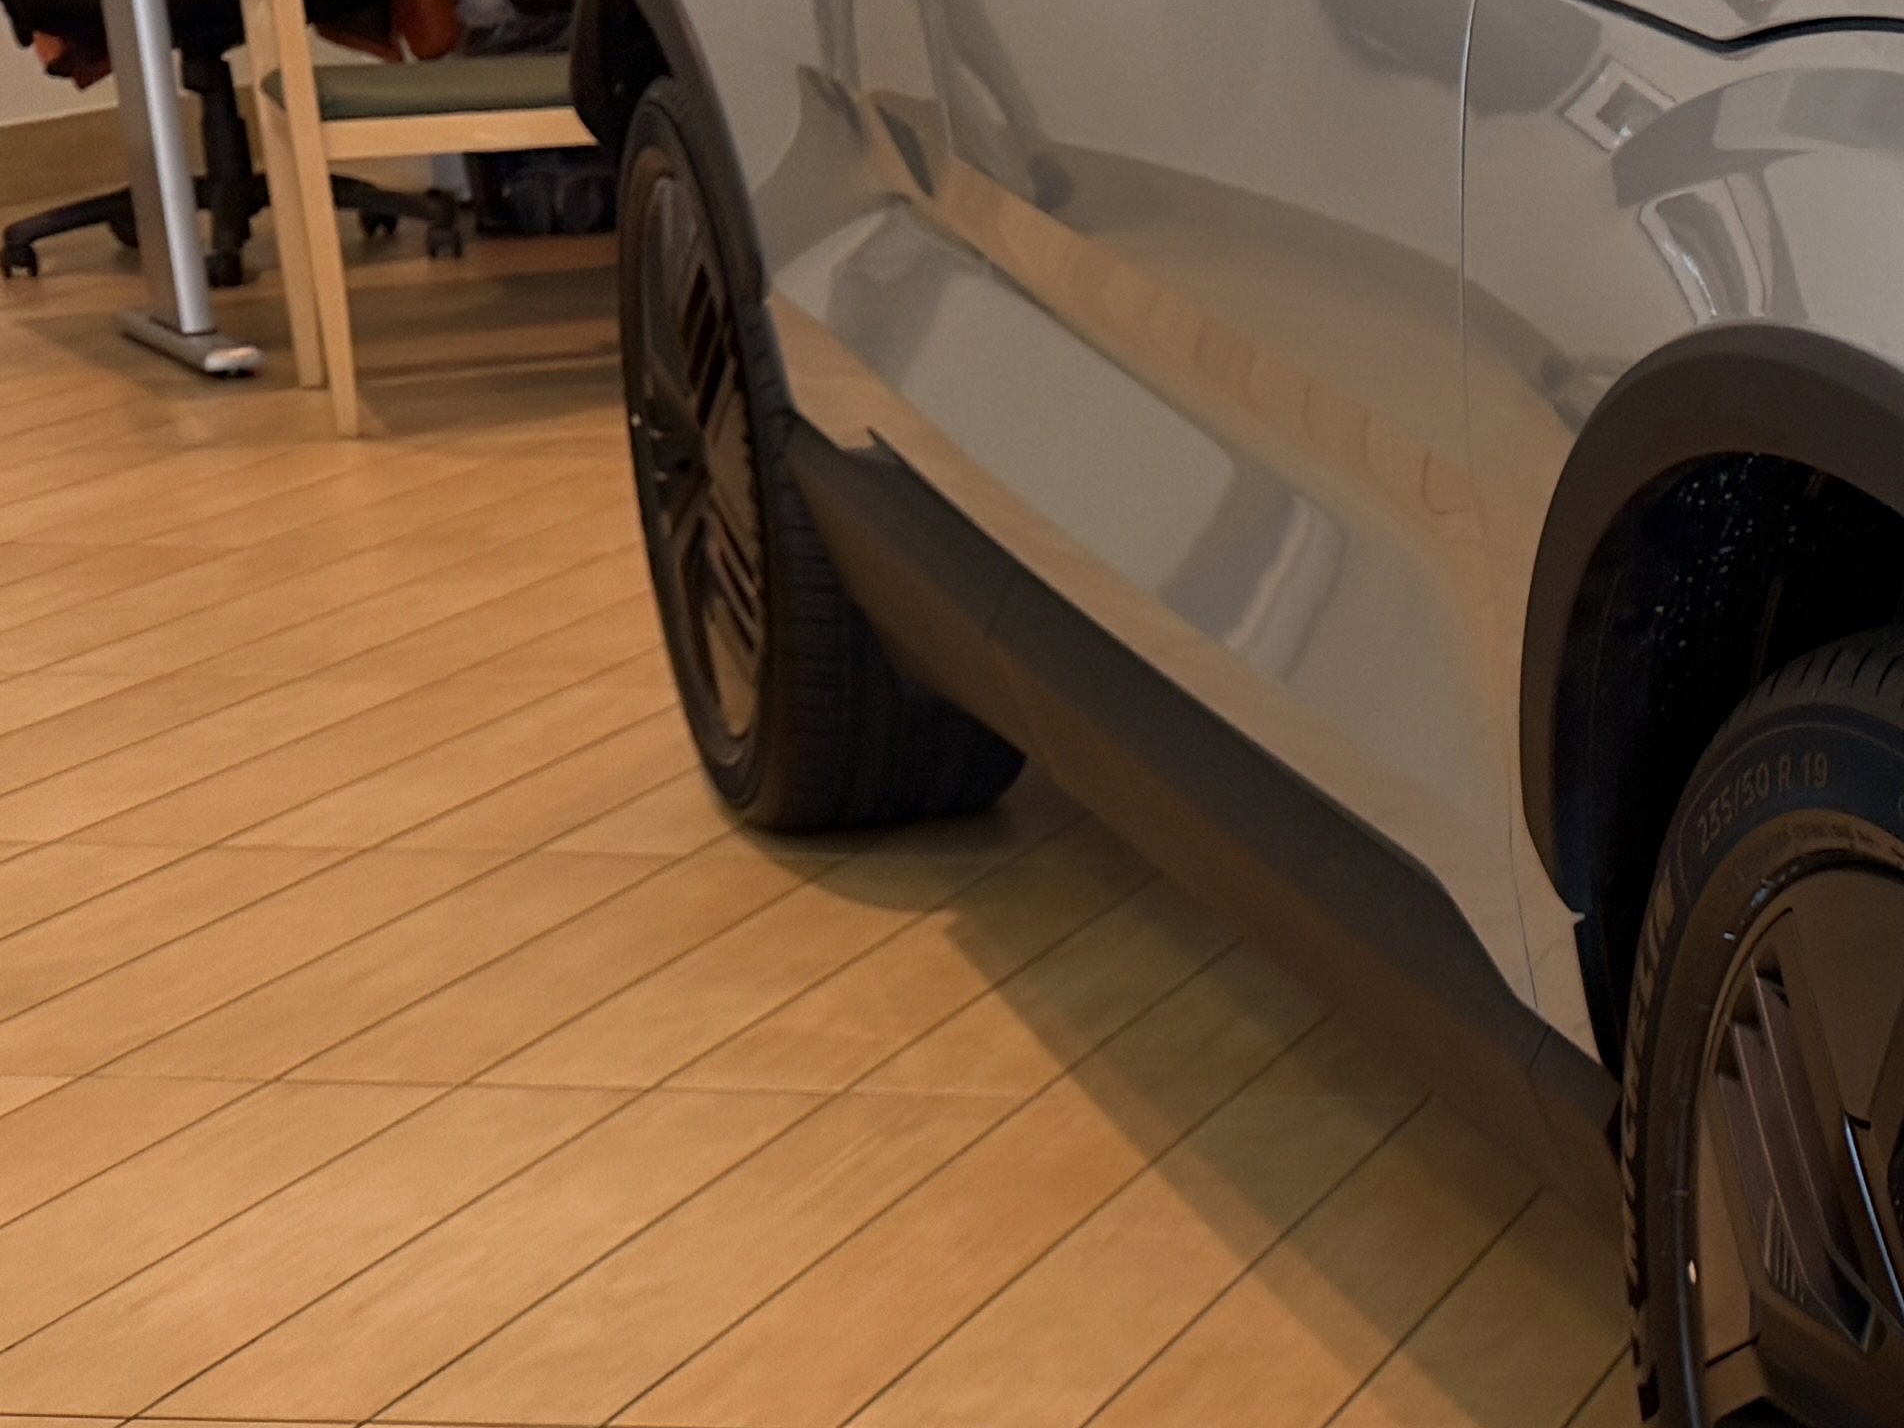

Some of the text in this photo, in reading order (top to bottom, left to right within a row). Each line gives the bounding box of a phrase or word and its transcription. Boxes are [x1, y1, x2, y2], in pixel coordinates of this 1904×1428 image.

[1697, 753, 1828, 854] 235/50 R 19
